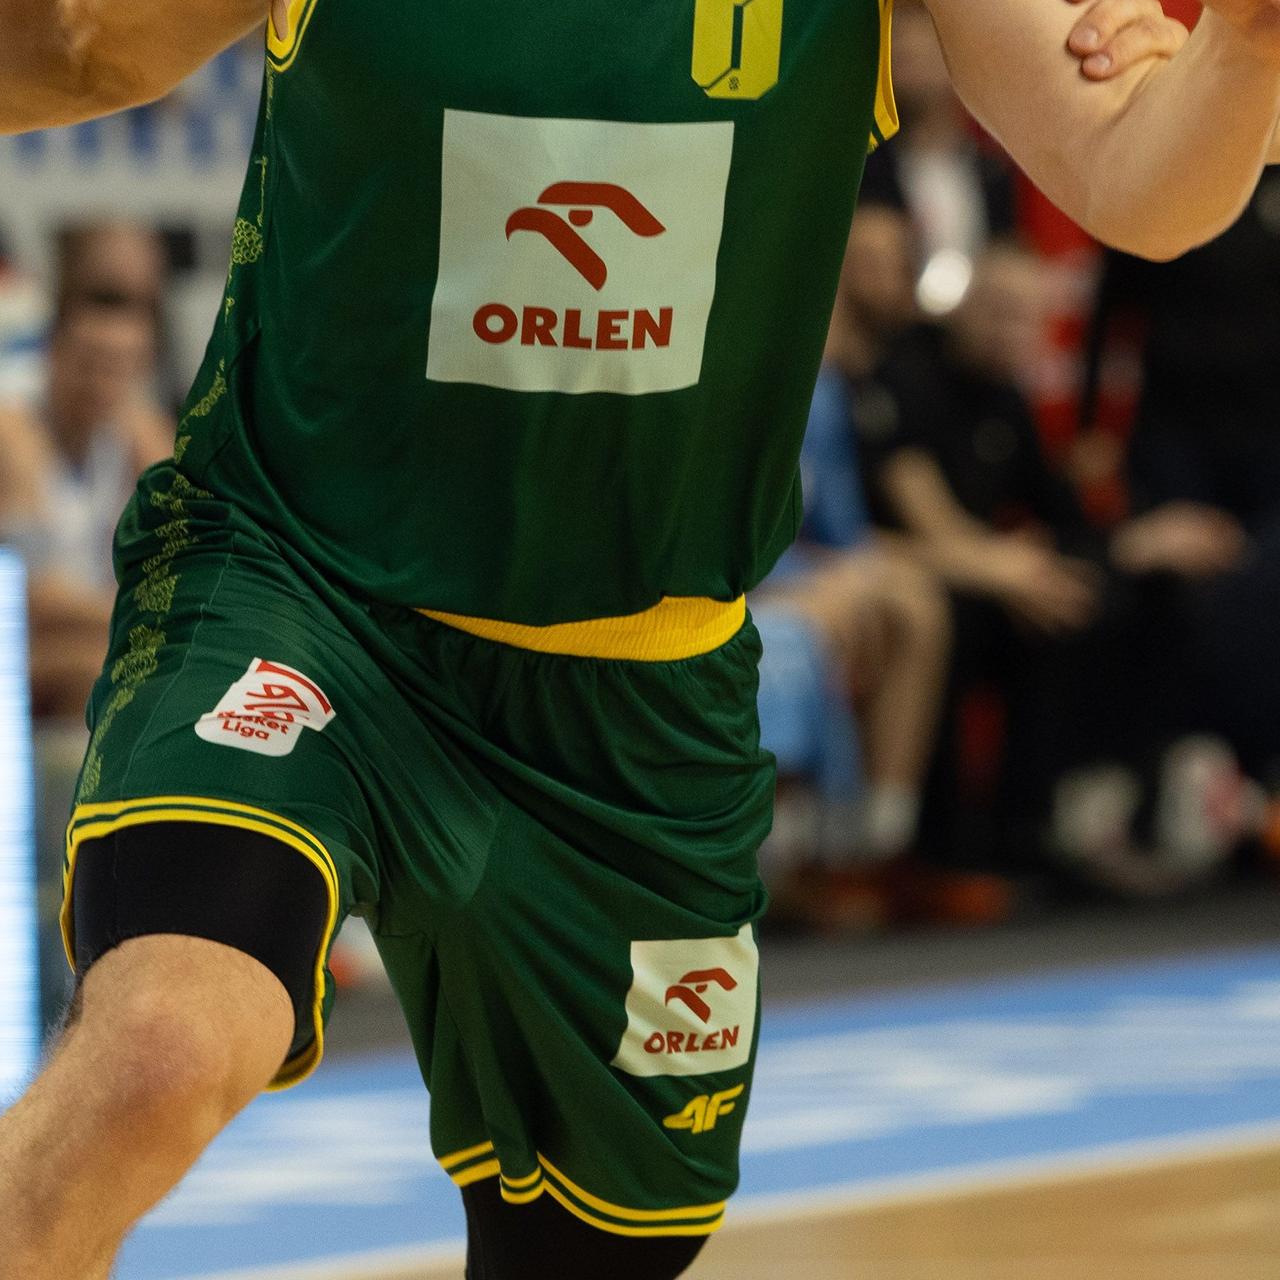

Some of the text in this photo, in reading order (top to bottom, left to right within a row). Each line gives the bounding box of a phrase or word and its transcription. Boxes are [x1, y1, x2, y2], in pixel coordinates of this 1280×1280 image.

[472, 303, 673, 351] ORLEN
[222, 719, 269, 740] Liga
[644, 1025, 740, 1055] ORLEN
[662, 1083, 745, 1135] 4F
